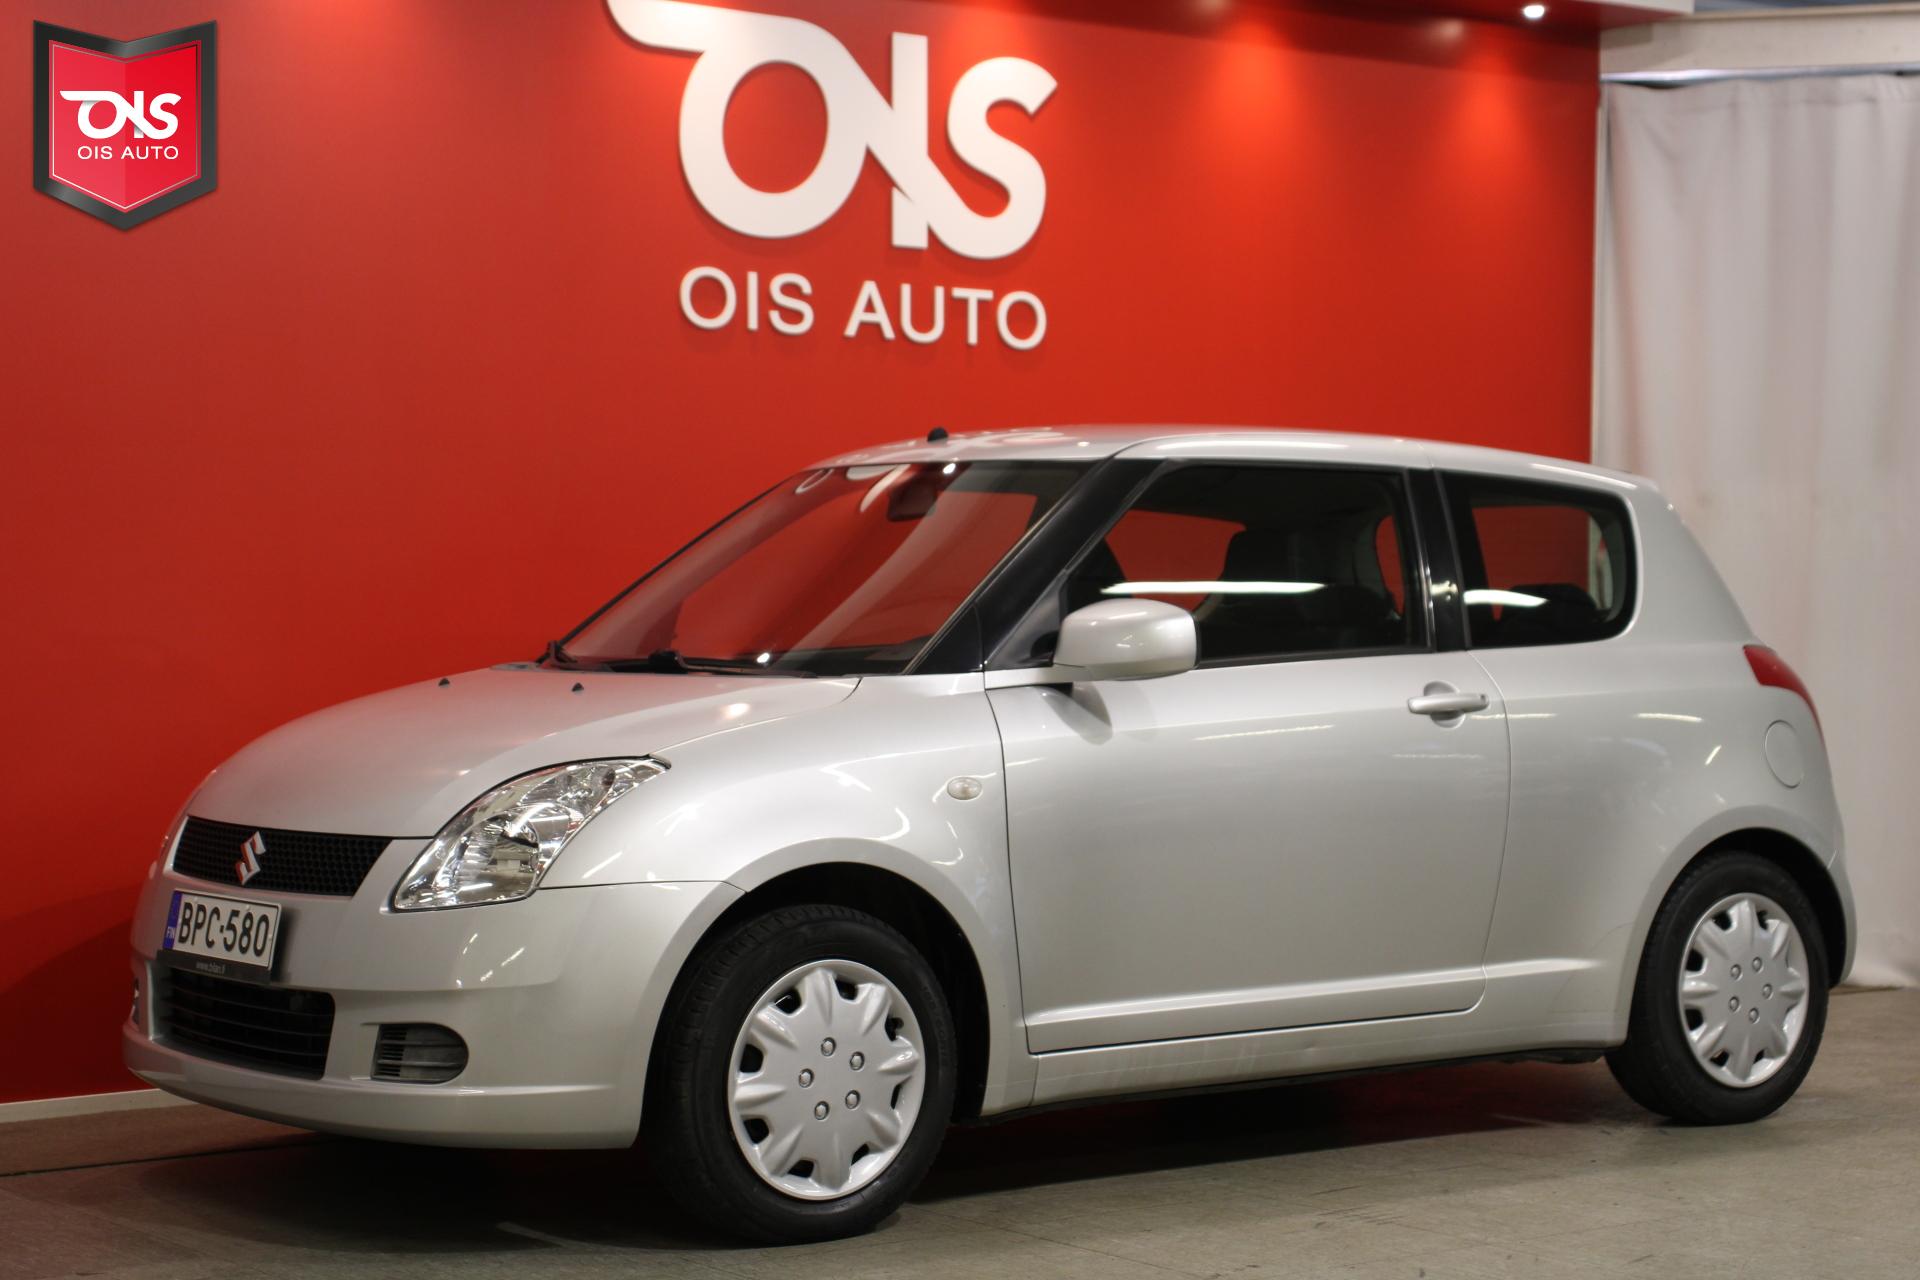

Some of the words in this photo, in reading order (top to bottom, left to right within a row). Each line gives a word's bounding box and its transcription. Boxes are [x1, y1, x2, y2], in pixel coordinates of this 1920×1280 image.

[604, 0, 1058, 260] OIS
[679, 266, 815, 335] OIS
[843, 279, 1048, 350] AUTO
